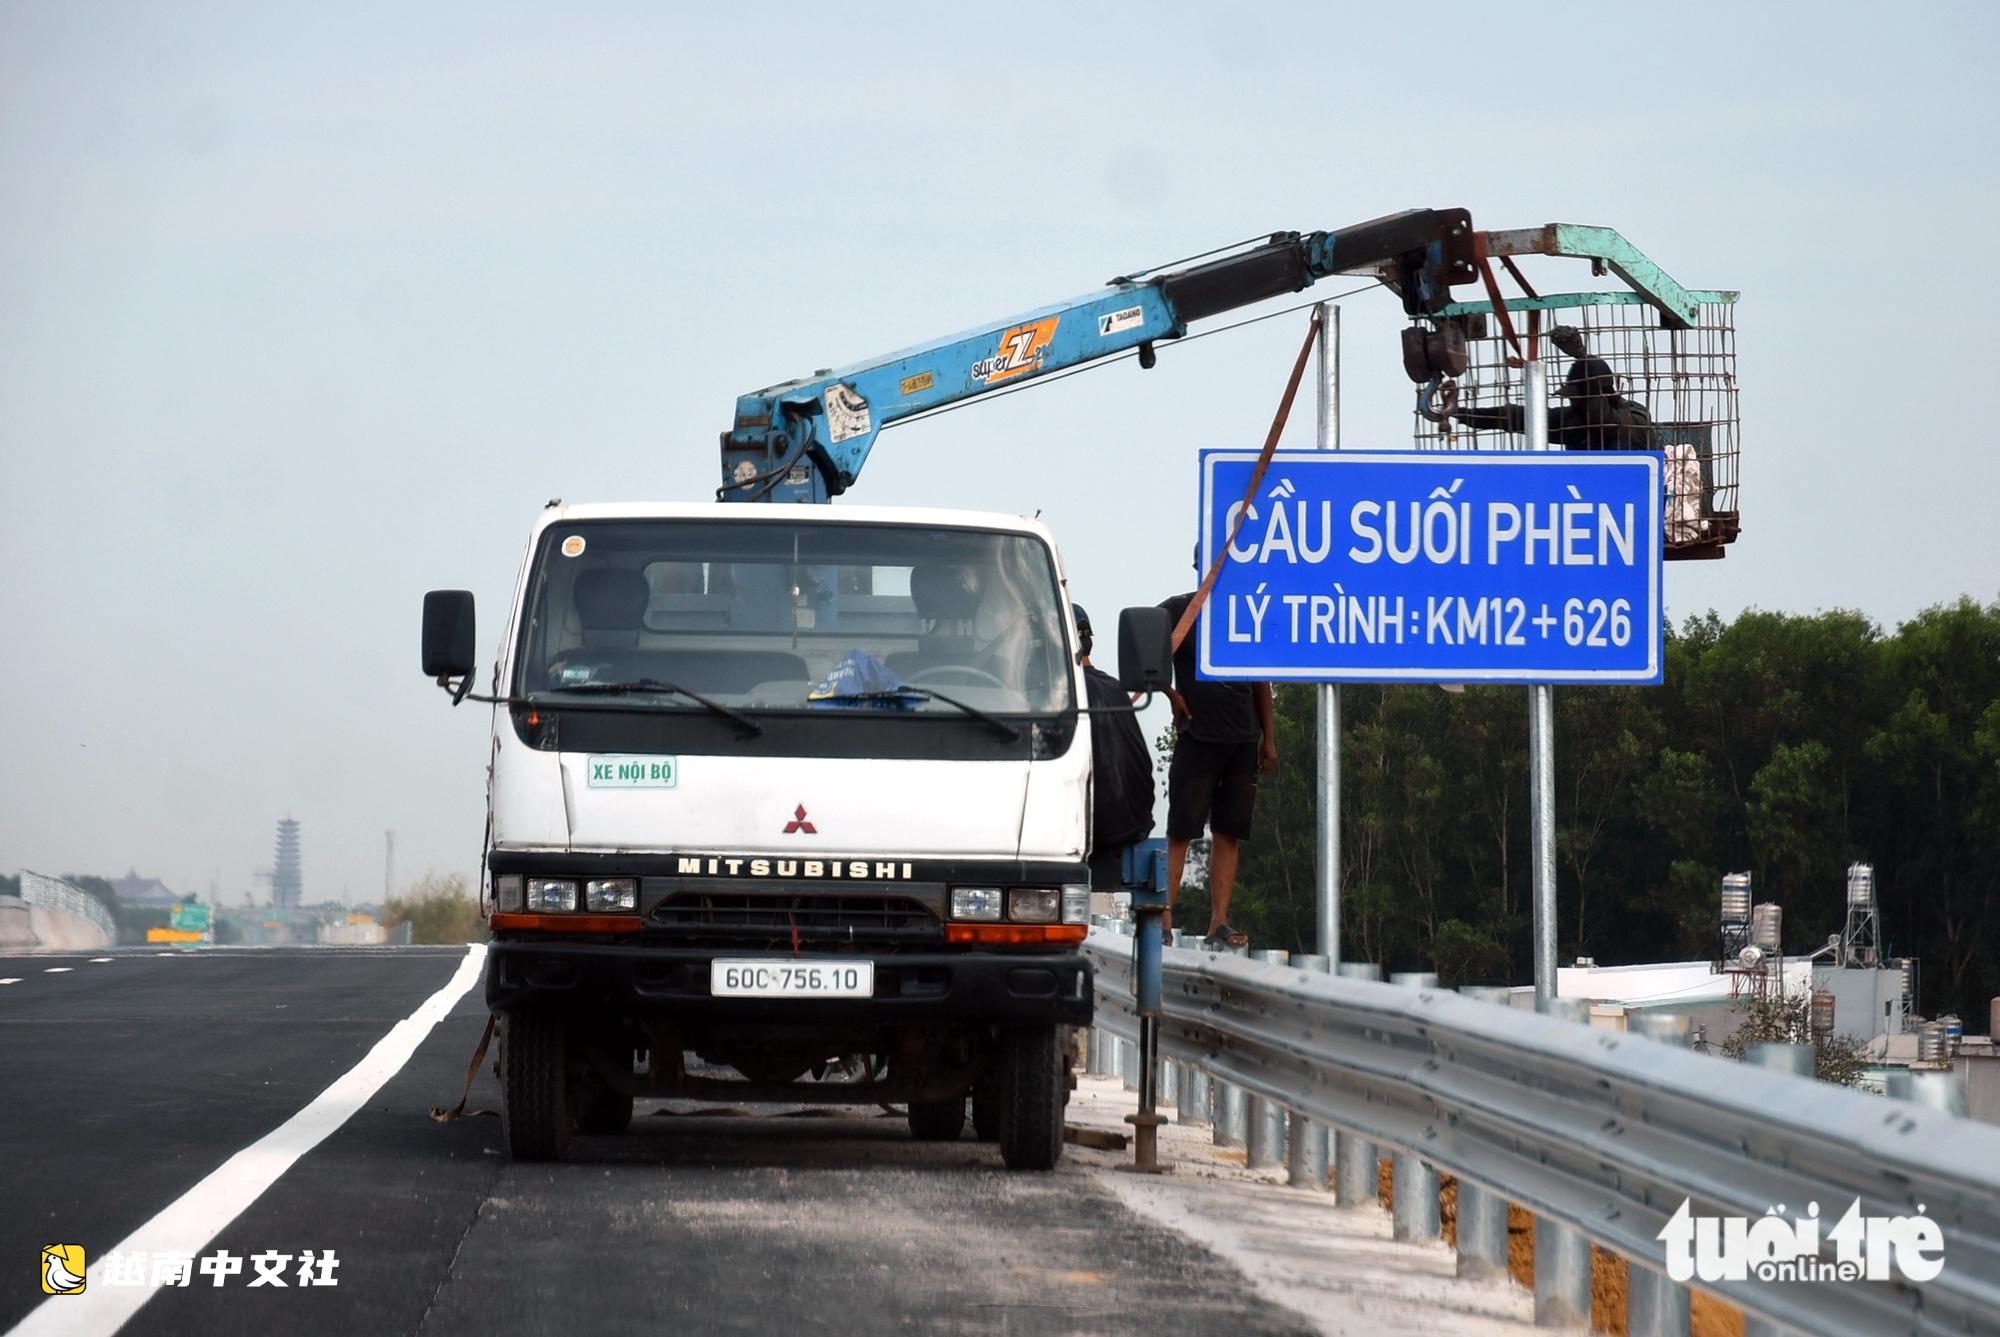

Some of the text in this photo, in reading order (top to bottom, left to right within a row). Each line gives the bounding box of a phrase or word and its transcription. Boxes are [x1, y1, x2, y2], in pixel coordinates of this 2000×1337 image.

[1225, 478, 1635, 567] CẦU SUỐI PHÈN
[1228, 582, 1271, 644] LÝ
[593, 761, 671, 783] XE NỘI BỘ
[678, 857, 913, 880] MITSUBISHI
